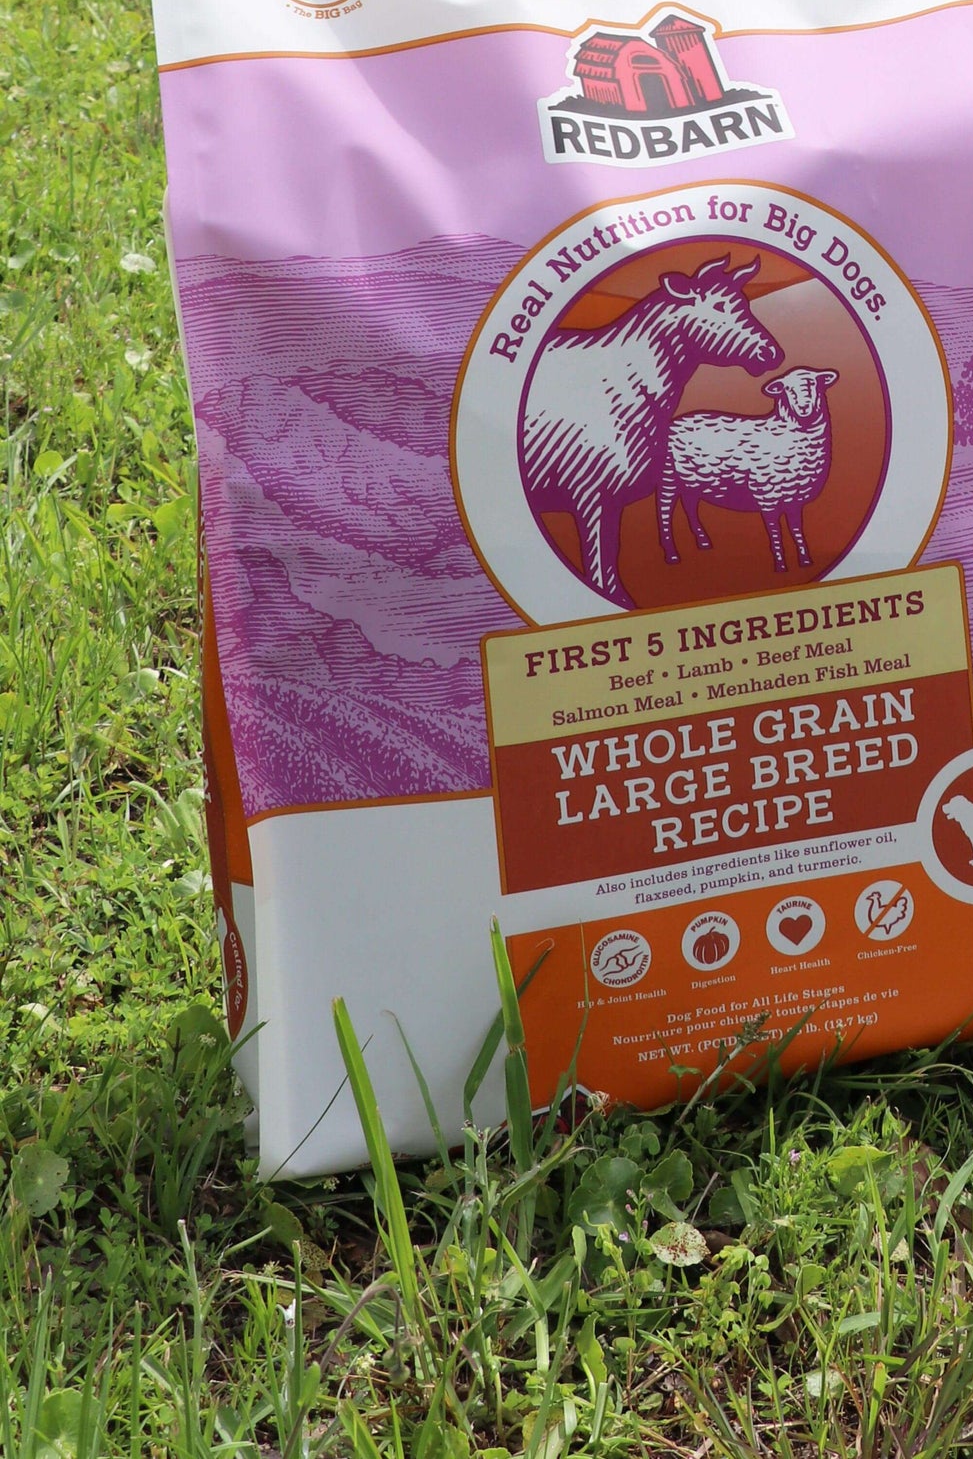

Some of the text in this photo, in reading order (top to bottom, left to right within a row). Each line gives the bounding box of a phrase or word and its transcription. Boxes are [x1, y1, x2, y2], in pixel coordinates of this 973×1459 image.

[293, 0, 363, 20] The BIG Bag
[549, 101, 784, 160] REDBARN
[488, 195, 887, 364] Real Nutrition for Big Dogs.
[524, 590, 925, 678] FIRST 5 INGREDIENTS
[608, 638, 854, 691] Beef Lamb Beef Meal
[552, 653, 912, 727] Salmon Meal Menhaden Fish Meal
[550, 687, 916, 780] WHOLE GRAIN
[554, 732, 920, 827] LARGE BREED
[651, 788, 835, 854] RECIPE
[595, 831, 898, 896] Also includes ingredients like sunflower oil,
[634, 854, 862, 905] flaxseed, pumpkin, and turmeric.
[690, 915, 729, 933] PUMPKIN
[776, 899, 813, 915] TAURINE
[592, 932, 641, 967] GLUCOSAMINE
[602, 953, 650, 986] CHONDROITIN
[770, 957, 831, 975] Heart Health
[856, 943, 918, 960] Chicken-Free
[576, 988, 668, 1010] Hp & Joint Health
[667, 984, 845, 1024] Dog Food for All Life Stages
[690, 973, 737, 990] Digestion
[686, 1019, 716, 1034] pour
[862, 989, 879, 1002] de
[881, 987, 900, 999] vie
[637, 1046, 667, 1063] NET
[671, 1042, 695, 1057] WT.
[805, 1021, 822, 1034] lb.
[856, 1011, 879, 1027] kg)
